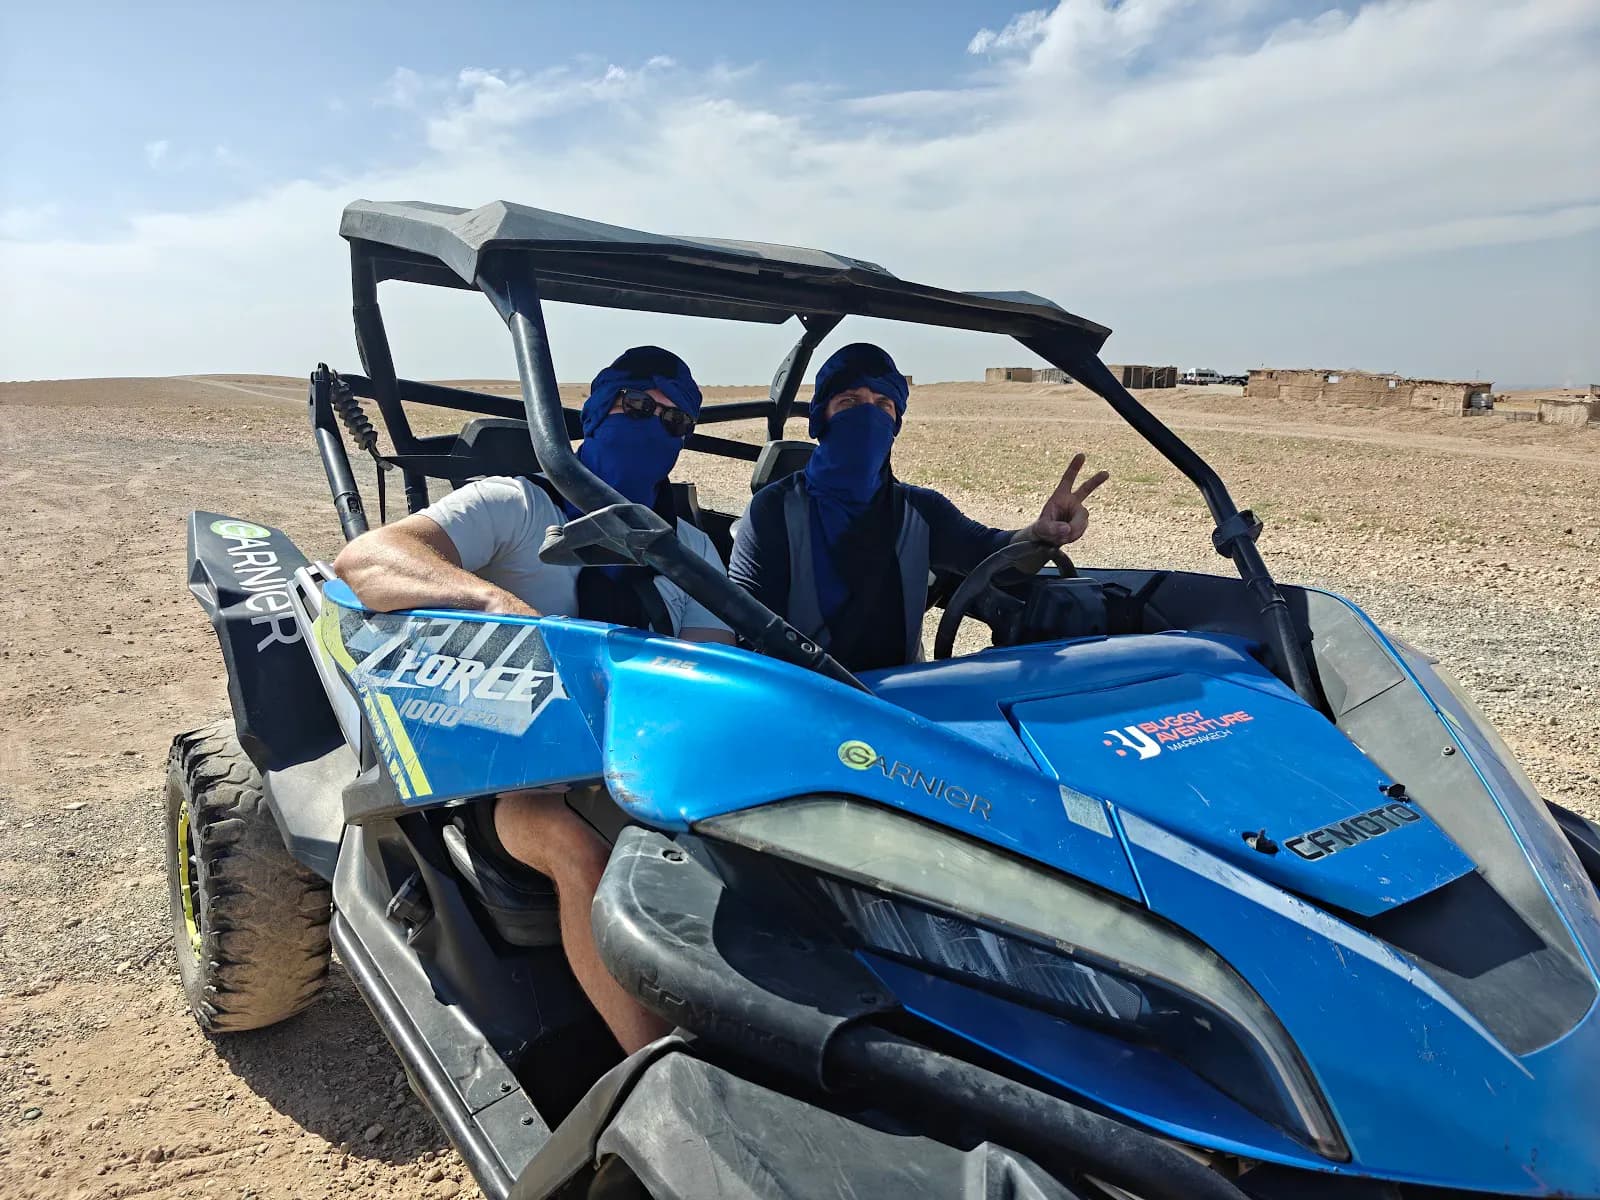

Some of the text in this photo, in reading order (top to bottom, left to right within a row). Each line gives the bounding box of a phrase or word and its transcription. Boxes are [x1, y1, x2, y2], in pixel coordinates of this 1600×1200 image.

[400, 698, 463, 728] 1000
[1138, 710, 1204, 733] BUGGY
[1155, 710, 1254, 744] AVENTURE
[1166, 729, 1233, 752] MARRAKECH
[1284, 802, 1421, 861] CFMOTO
